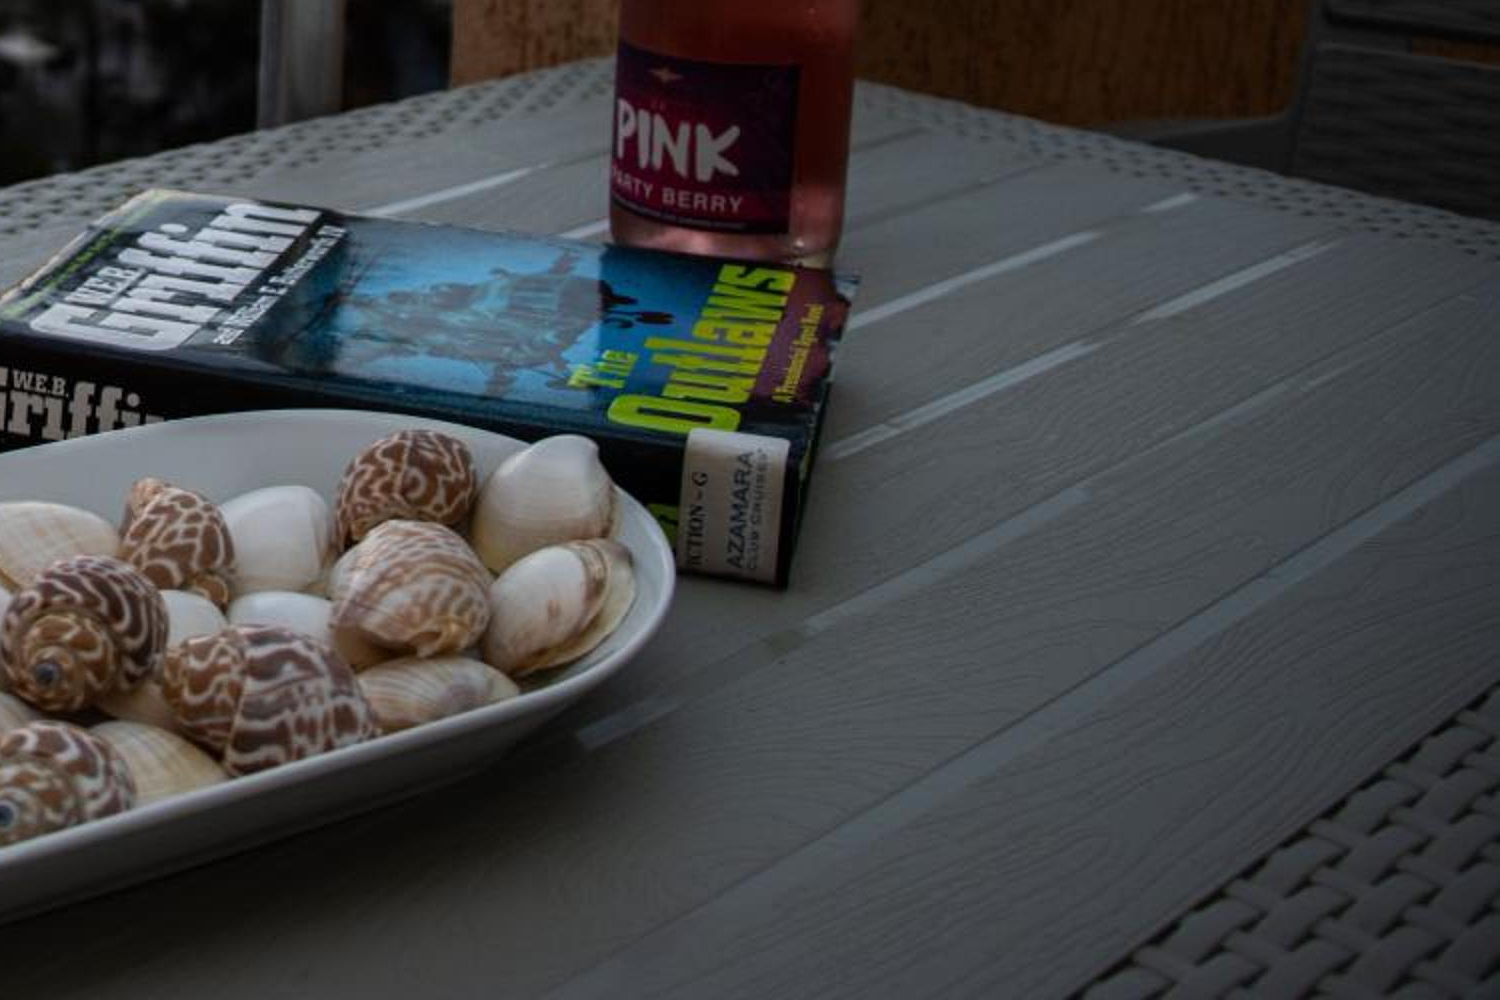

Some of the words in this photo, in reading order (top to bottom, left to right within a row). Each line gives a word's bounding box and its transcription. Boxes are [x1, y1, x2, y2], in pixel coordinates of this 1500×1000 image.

[616, 97, 741, 183] PINK
[661, 187, 744, 214] BERRY
[30, 203, 323, 351] Griffin
[567, 350, 639, 389] The
[607, 263, 797, 434] Outlaws
[691, 472, 708, 487] G
[726, 452, 754, 569] AZAMARA
[685, 503, 707, 567] ICTION
